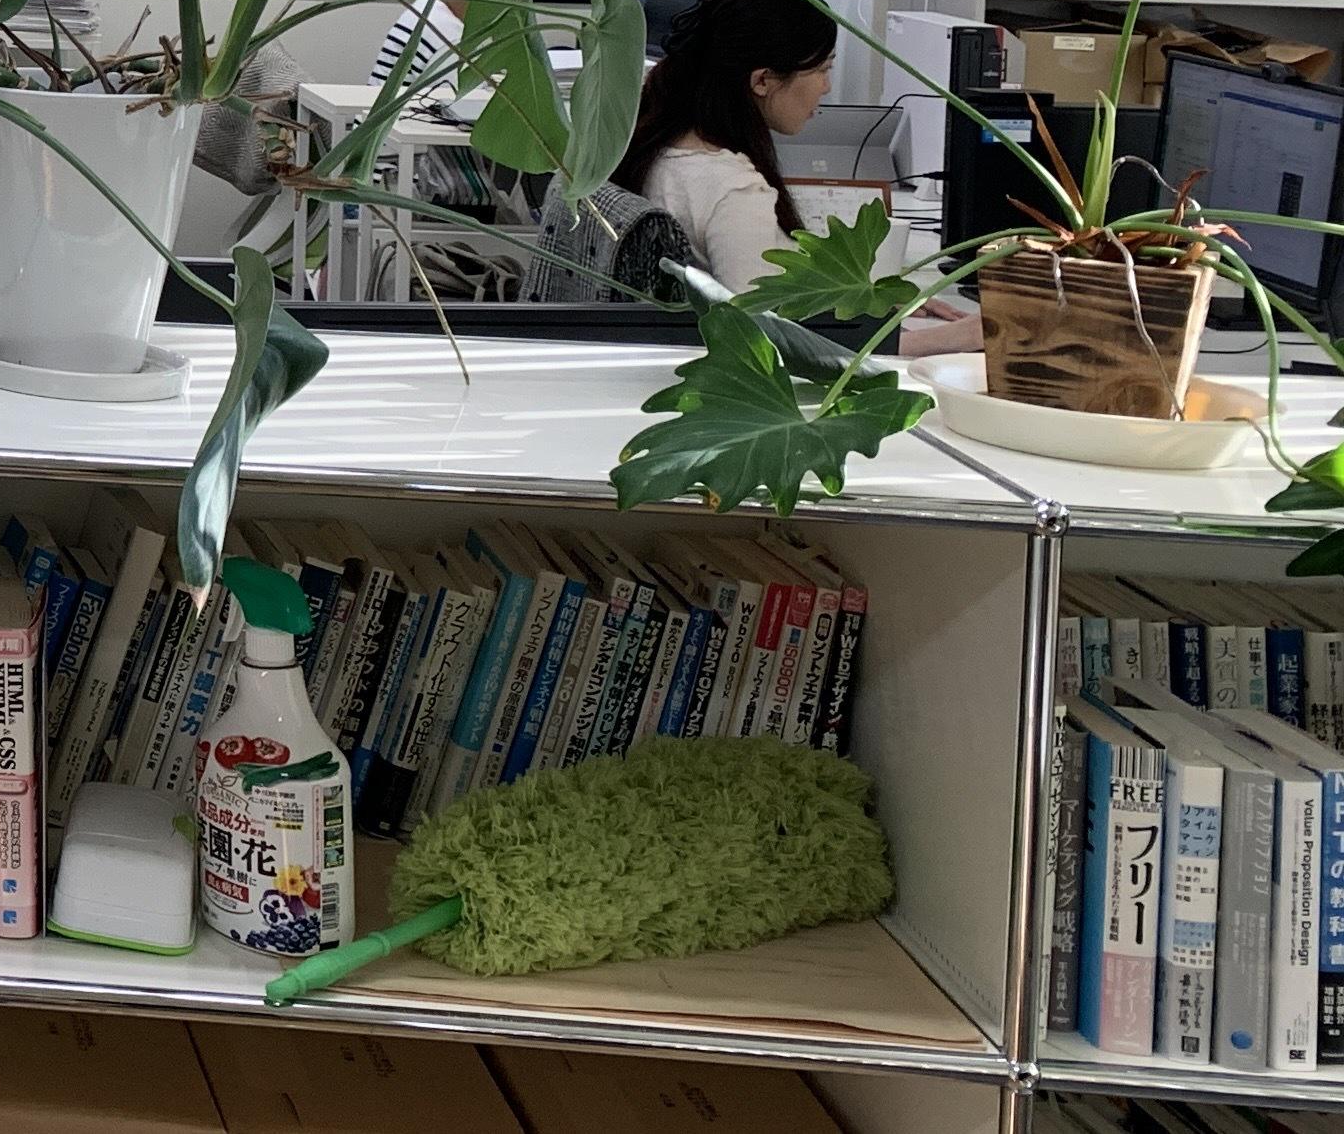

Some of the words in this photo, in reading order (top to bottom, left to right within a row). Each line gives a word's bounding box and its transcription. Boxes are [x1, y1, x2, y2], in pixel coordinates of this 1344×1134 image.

[58, 590, 106, 681] Facebook
[7, 662, 25, 715] HTML
[408, 601, 471, 765] クラウド化する世界
[1109, 782, 1164, 804] FREE
[1302, 798, 1315, 838] Value
[1052, 799, 1081, 954] マーケティング戦略
[1126, 824, 1160, 946] フリー
[1301, 840, 1314, 917] Proposition
[1299, 920, 1312, 967] Design
